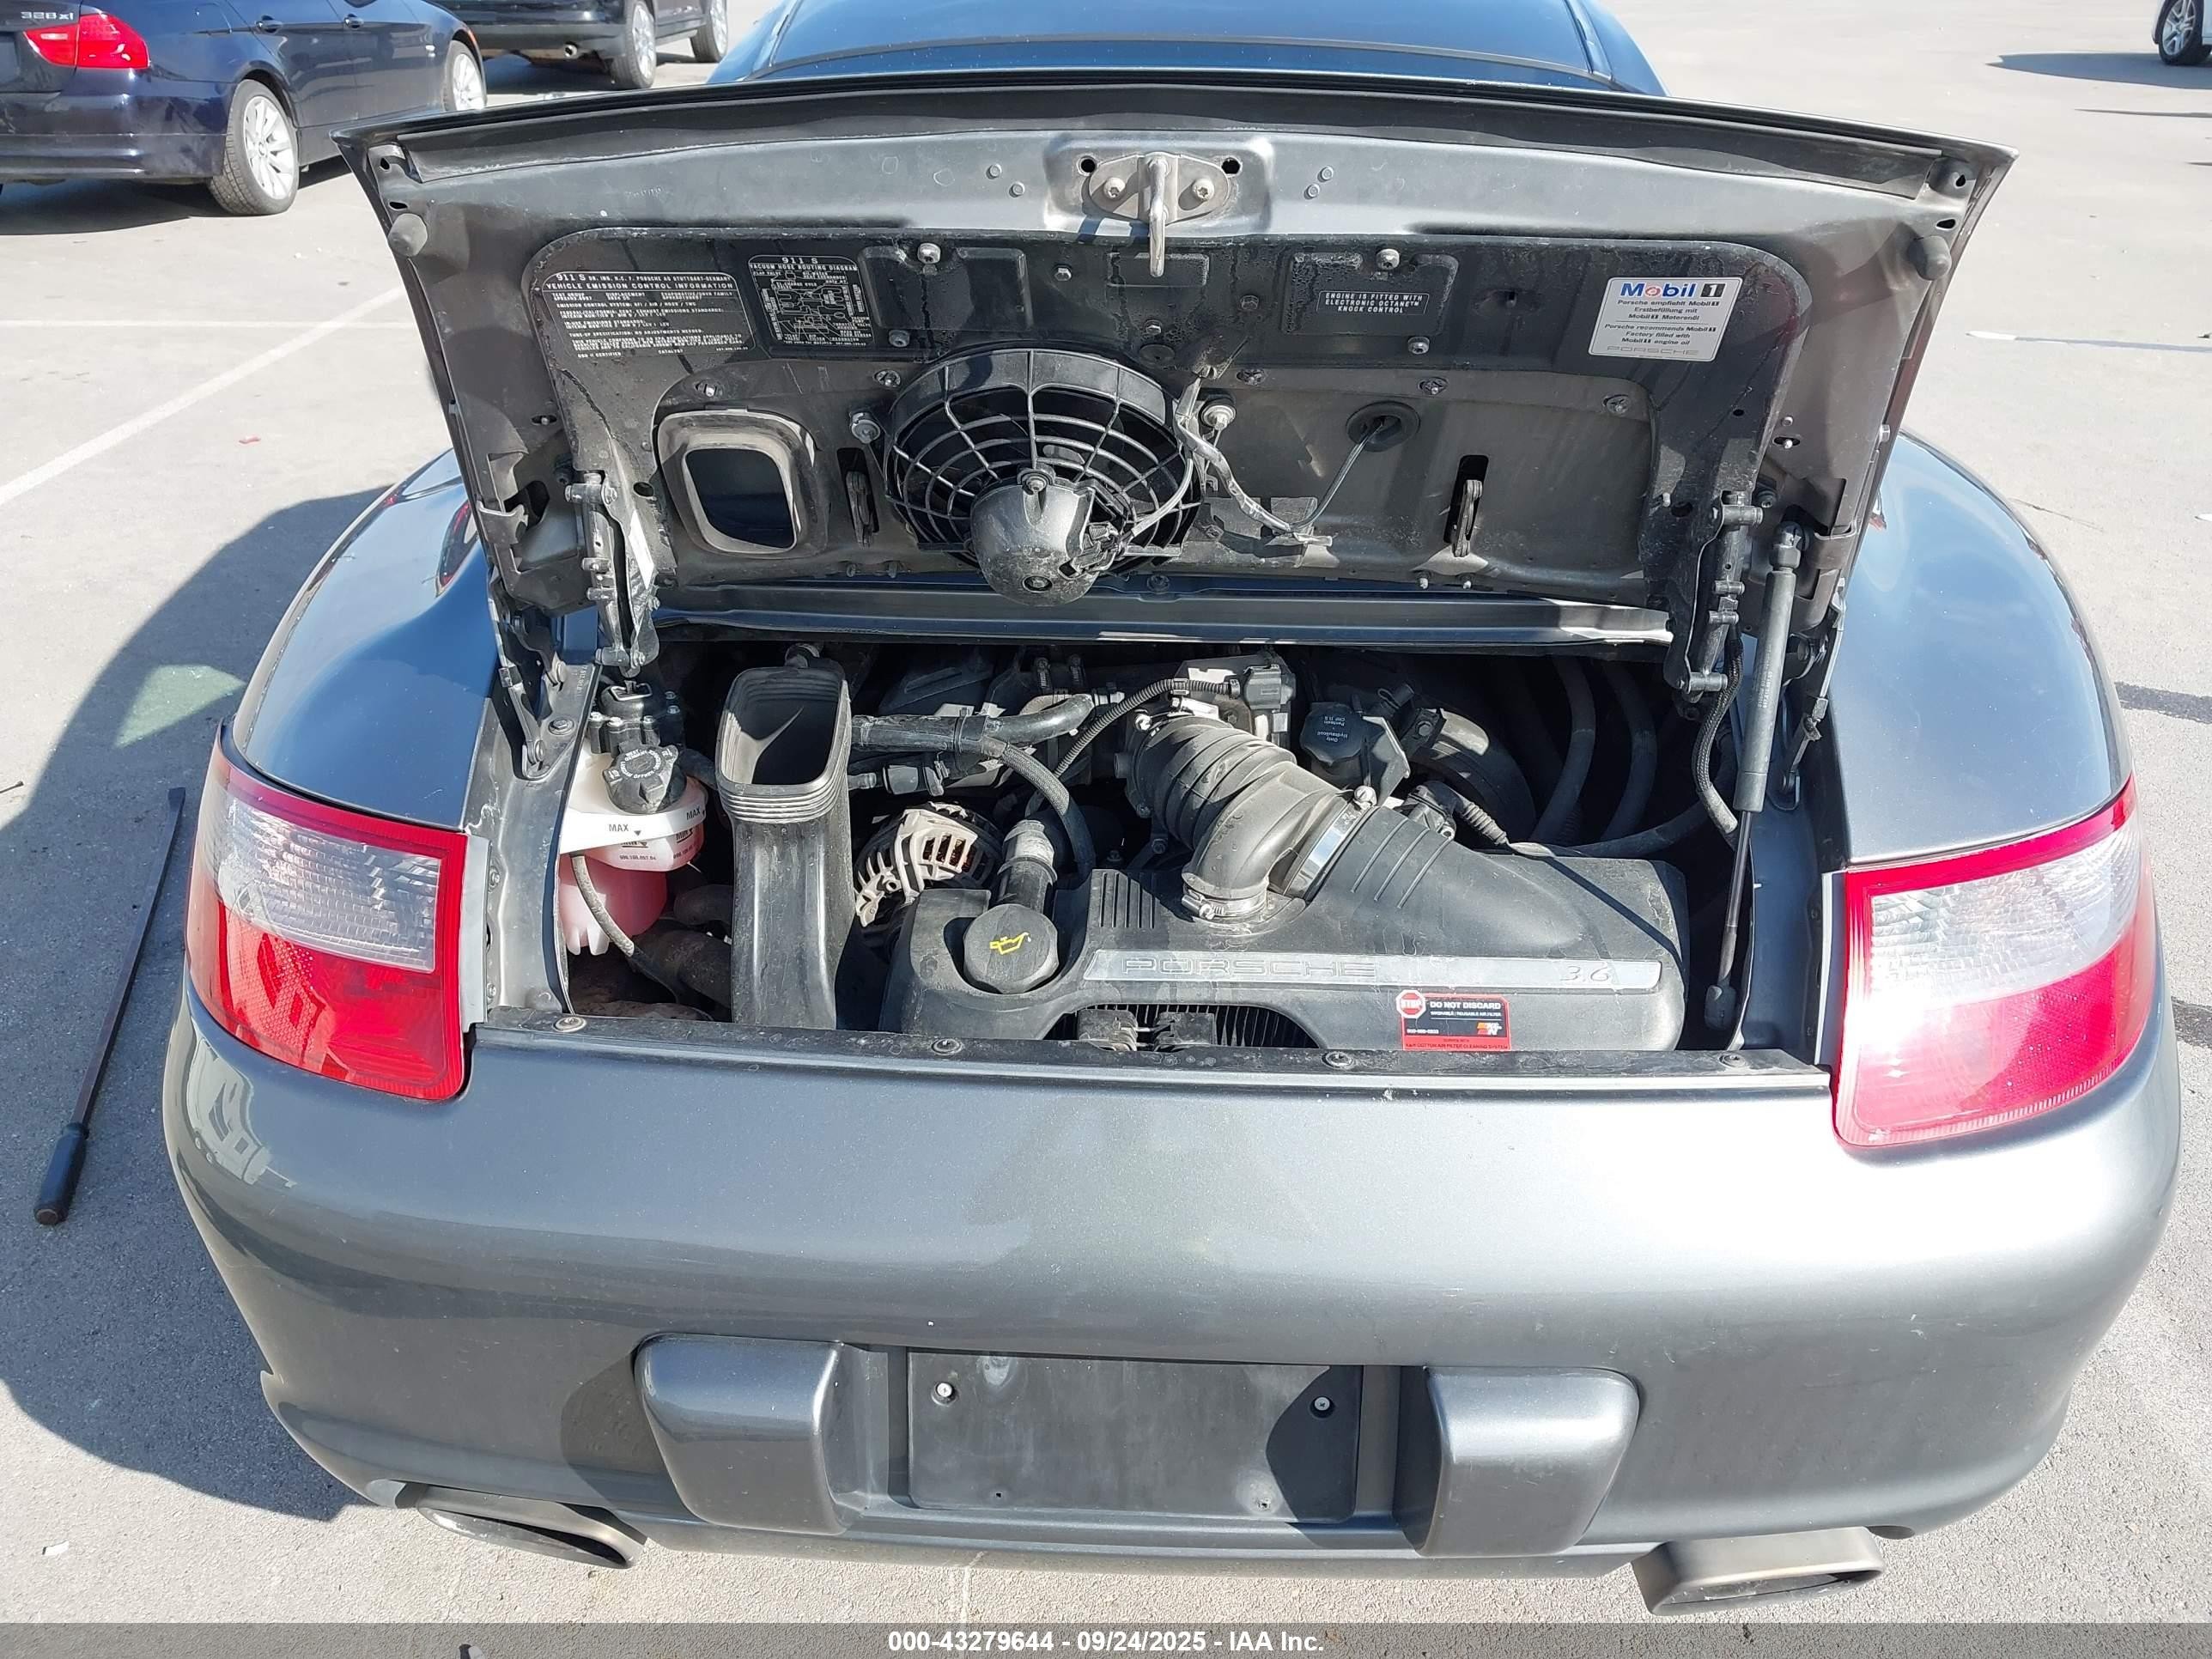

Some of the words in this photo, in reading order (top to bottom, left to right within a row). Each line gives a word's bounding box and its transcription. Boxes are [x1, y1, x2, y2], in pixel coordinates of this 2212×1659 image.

[1620, 283, 1697, 298] Mobil
[1607, 345, 1699, 356] PORSCHE
[686, 806, 702, 821] MAX
[608, 823, 629, 832] MAX
[1122, 957, 1377, 978] PORSCHE
[1559, 963, 1610, 983] 3.6
[1400, 999, 1423, 1009] STOP
[1429, 1000, 1443, 1009] DO
[1443, 1001, 1462, 1010] NOT
[1462, 1001, 1502, 1011] DISCARD
